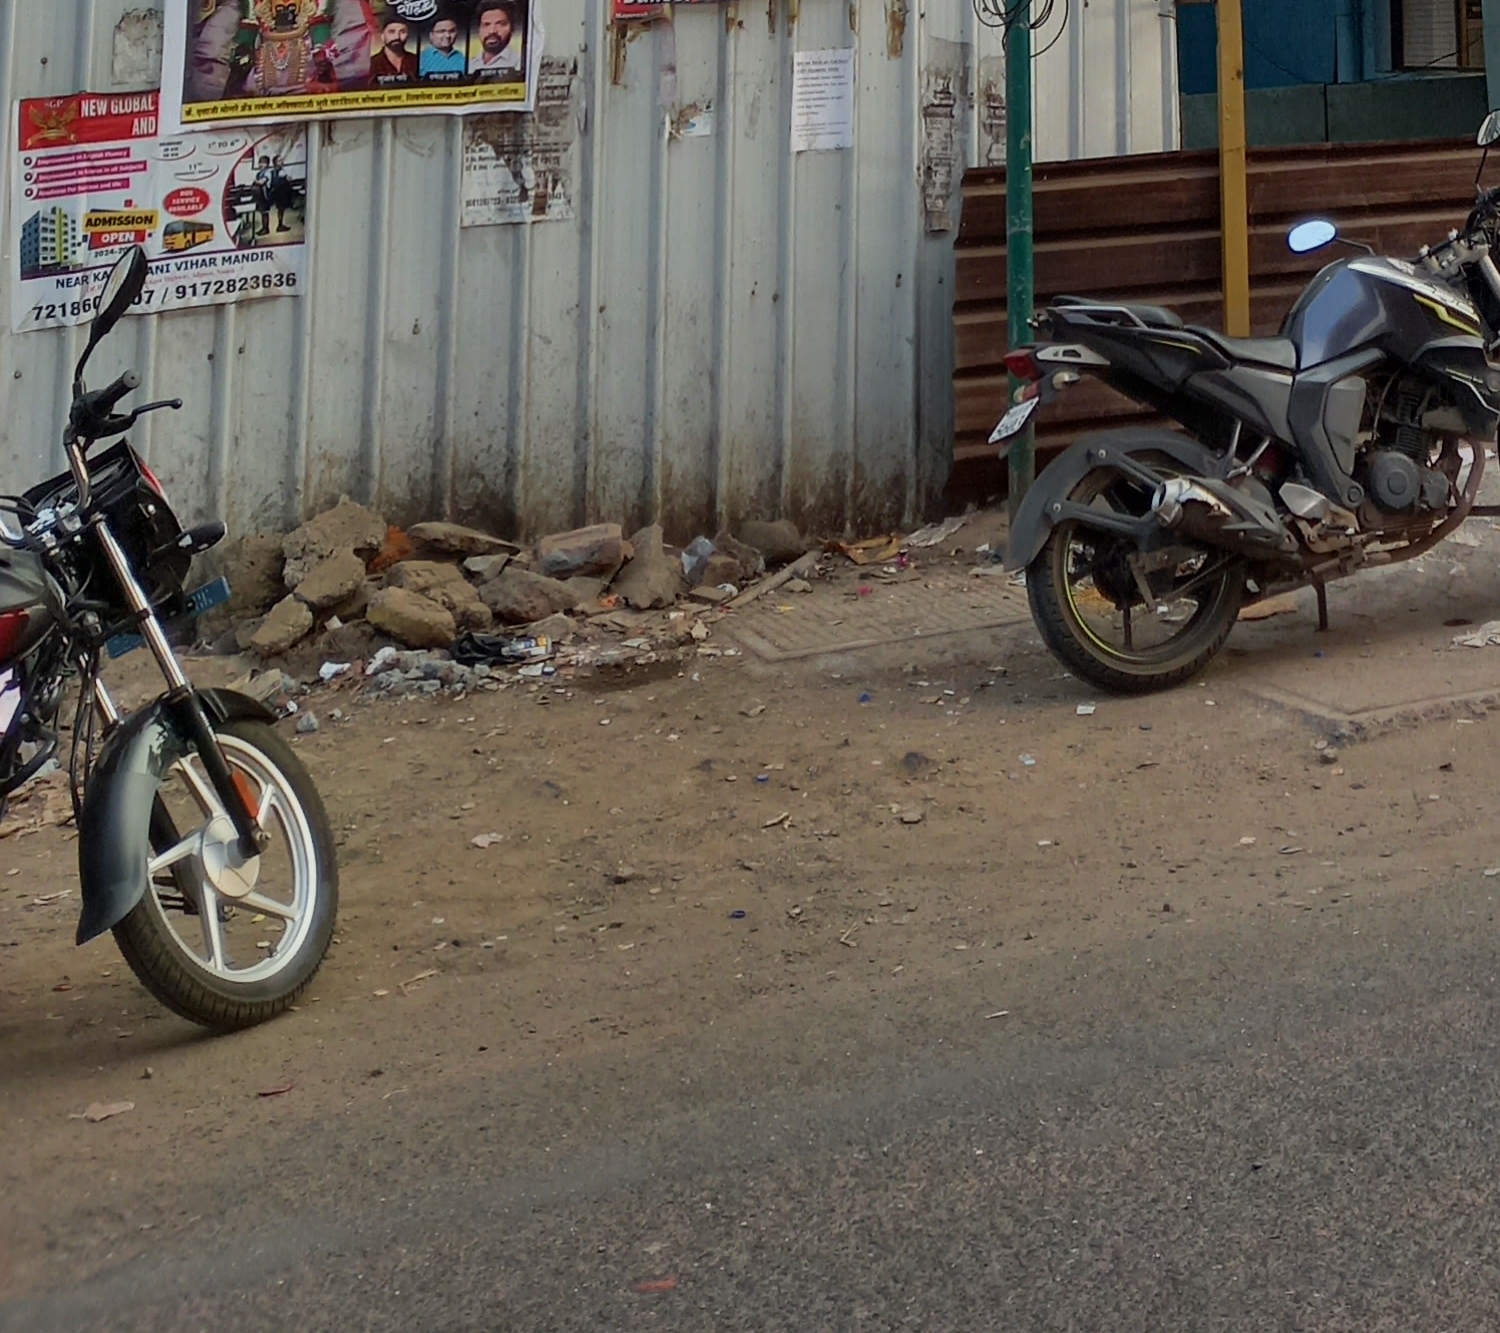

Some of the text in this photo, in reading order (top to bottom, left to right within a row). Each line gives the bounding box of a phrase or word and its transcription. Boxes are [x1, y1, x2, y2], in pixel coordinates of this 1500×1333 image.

[80, 94, 155, 118] NEW GLOBAL
[131, 116, 157, 136] AND
[85, 213, 154, 229] ADMISSION
[100, 231, 136, 244] OPEN
[93, 247, 127, 258] 2024-20
[55, 275, 90, 290] NEAR
[174, 255, 218, 272] VIHAR
[221, 250, 275, 267] MANDIR
[31, 289, 155, 322] 72186007
[174, 272, 297, 301] 9172823636
